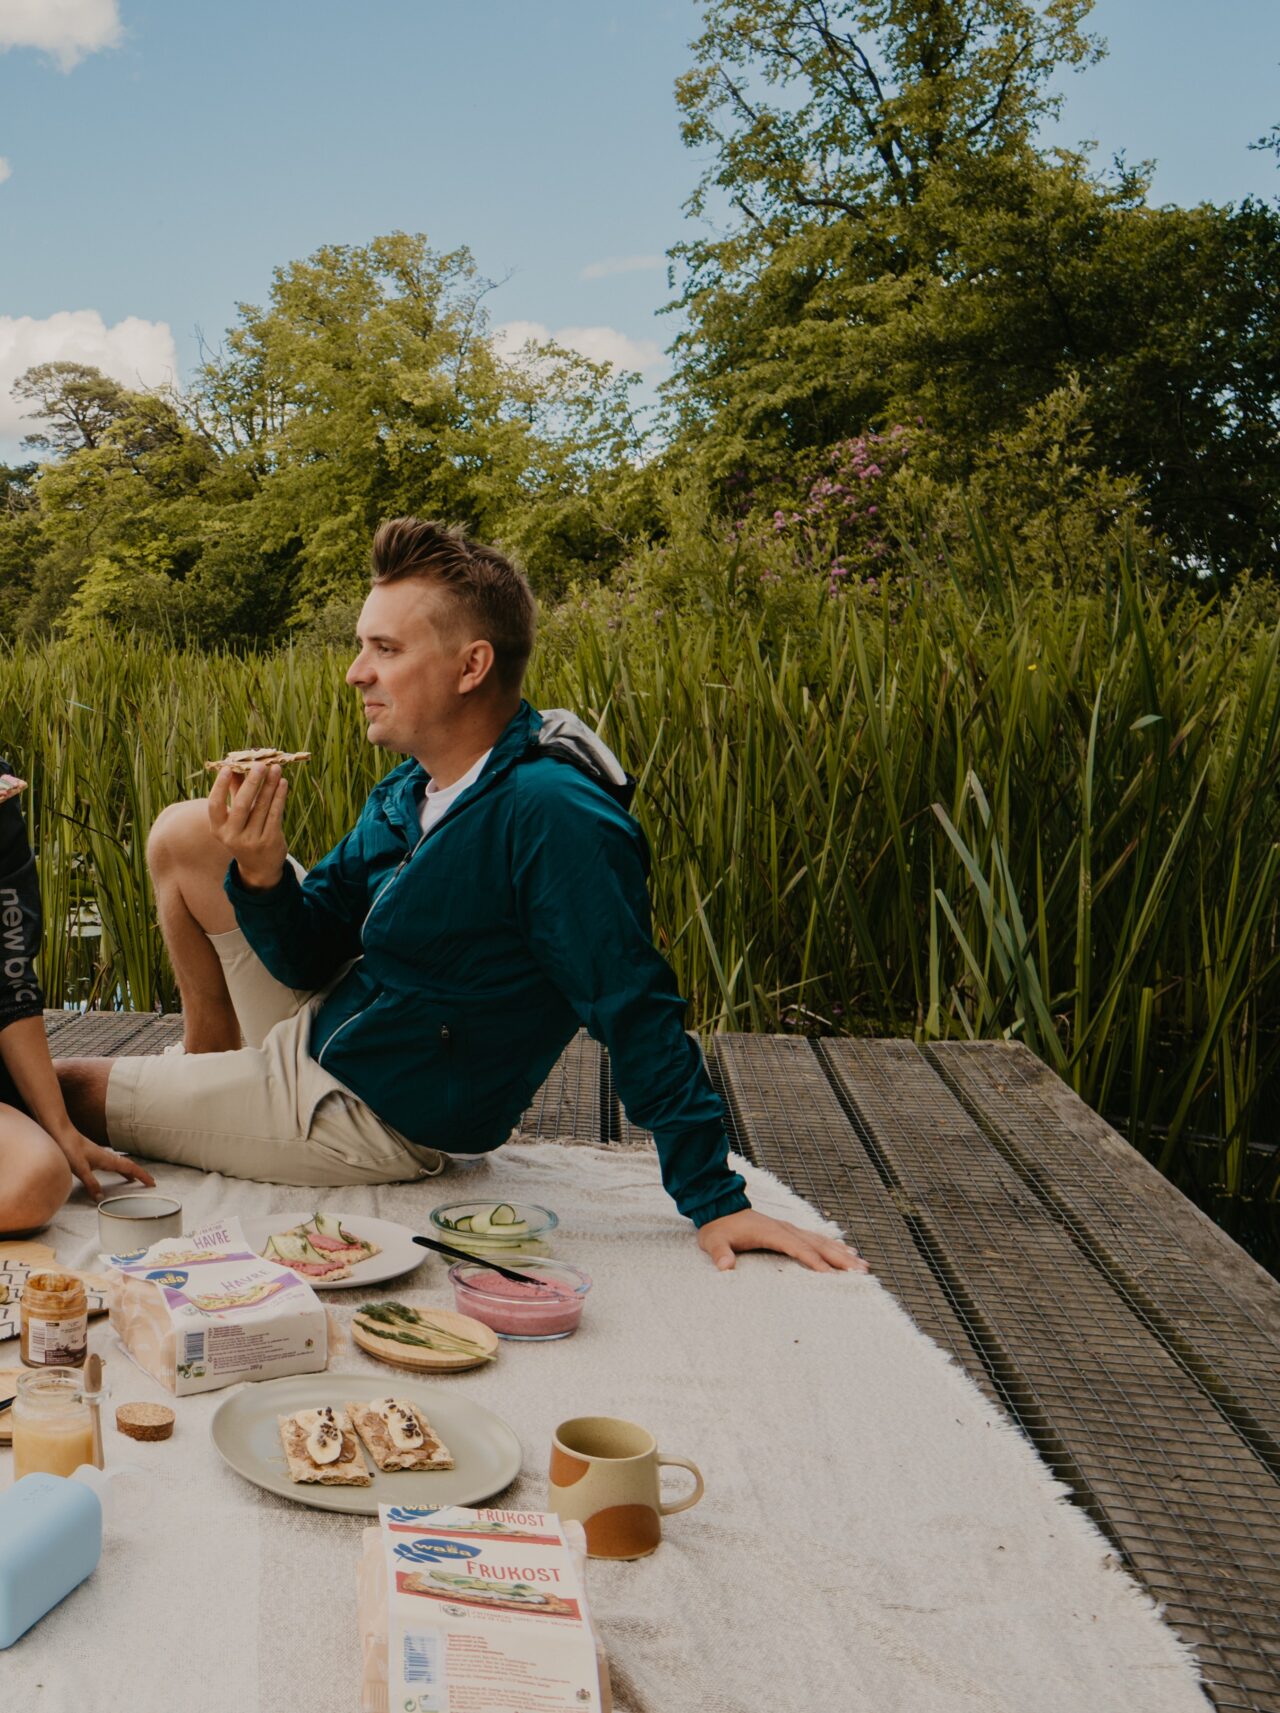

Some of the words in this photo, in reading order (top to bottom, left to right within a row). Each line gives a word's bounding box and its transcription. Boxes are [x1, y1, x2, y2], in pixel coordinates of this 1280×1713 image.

[0, 888, 25, 951] new
[193, 1230, 231, 1249] HAVRE
[221, 1270, 270, 1291] HAVRE
[477, 1509, 545, 1527] FRUKOST
[415, 1543, 473, 1558] wasa
[466, 1561, 561, 1582] FRUKOST
